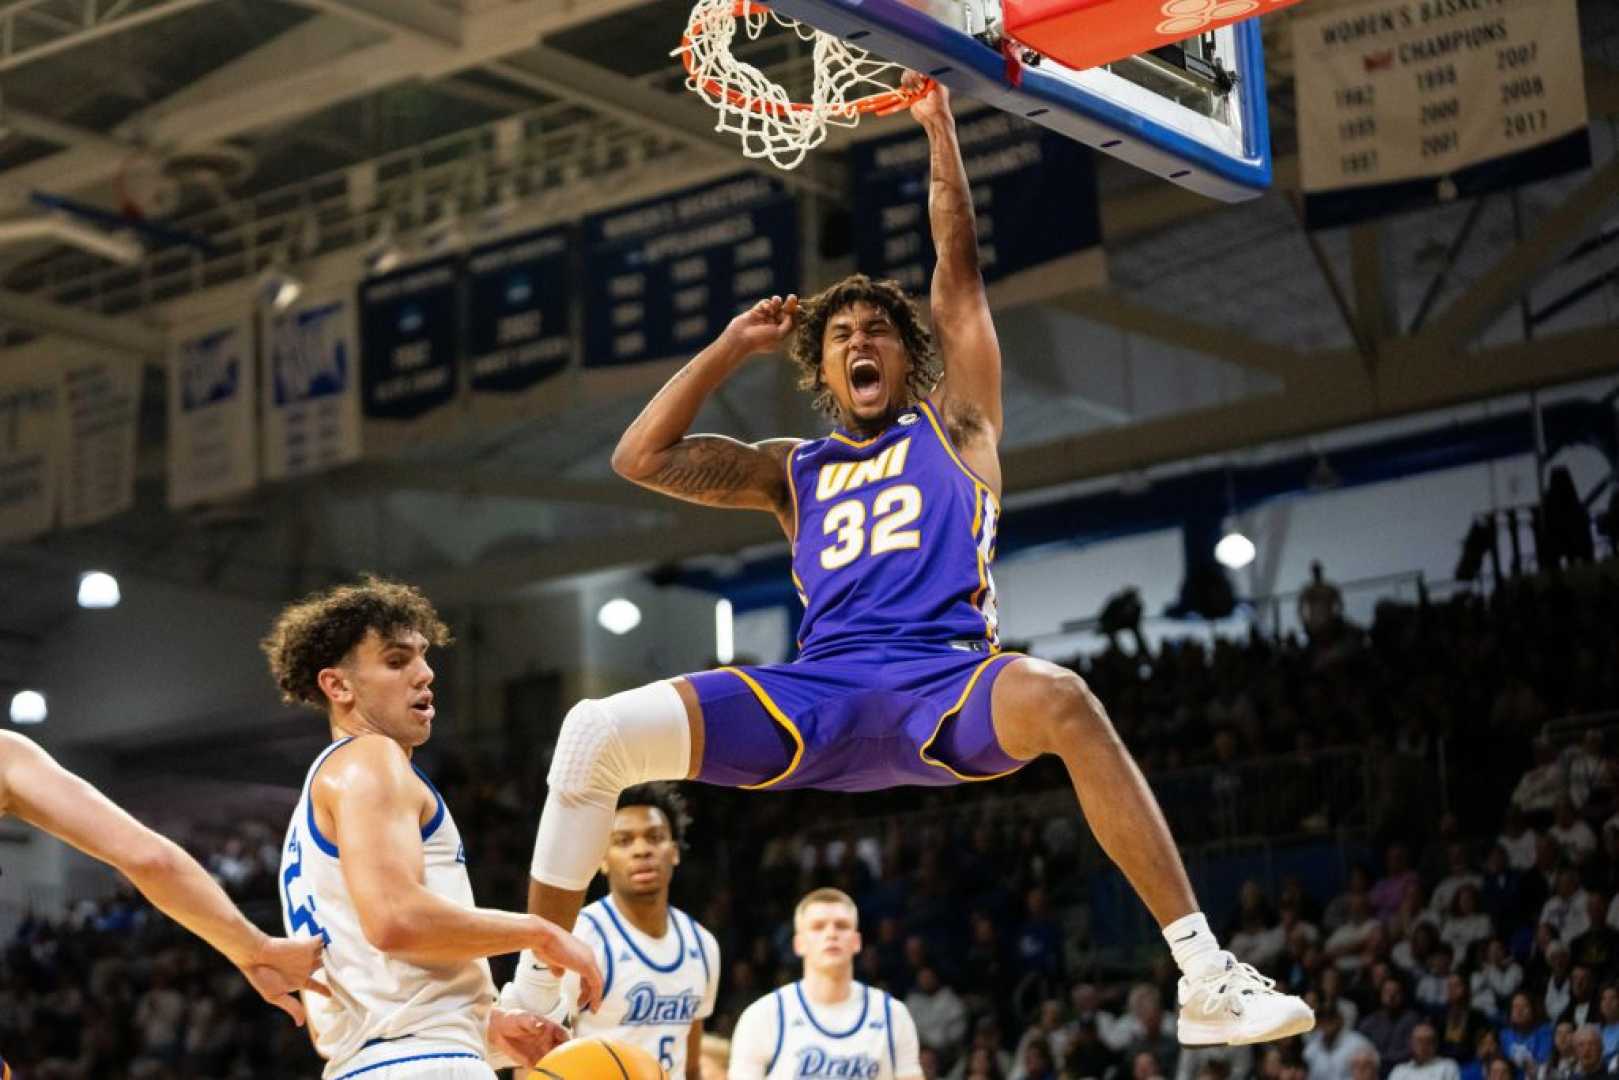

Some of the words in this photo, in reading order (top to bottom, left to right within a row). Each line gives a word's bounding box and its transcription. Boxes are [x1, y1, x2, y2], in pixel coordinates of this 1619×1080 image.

[1398, 20, 1507, 64] CHAMPIONS
[1504, 109, 1547, 138] 2017
[815, 437, 912, 502] UNI
[819, 484, 923, 571] 32
[795, 1045, 880, 1080] Drake
